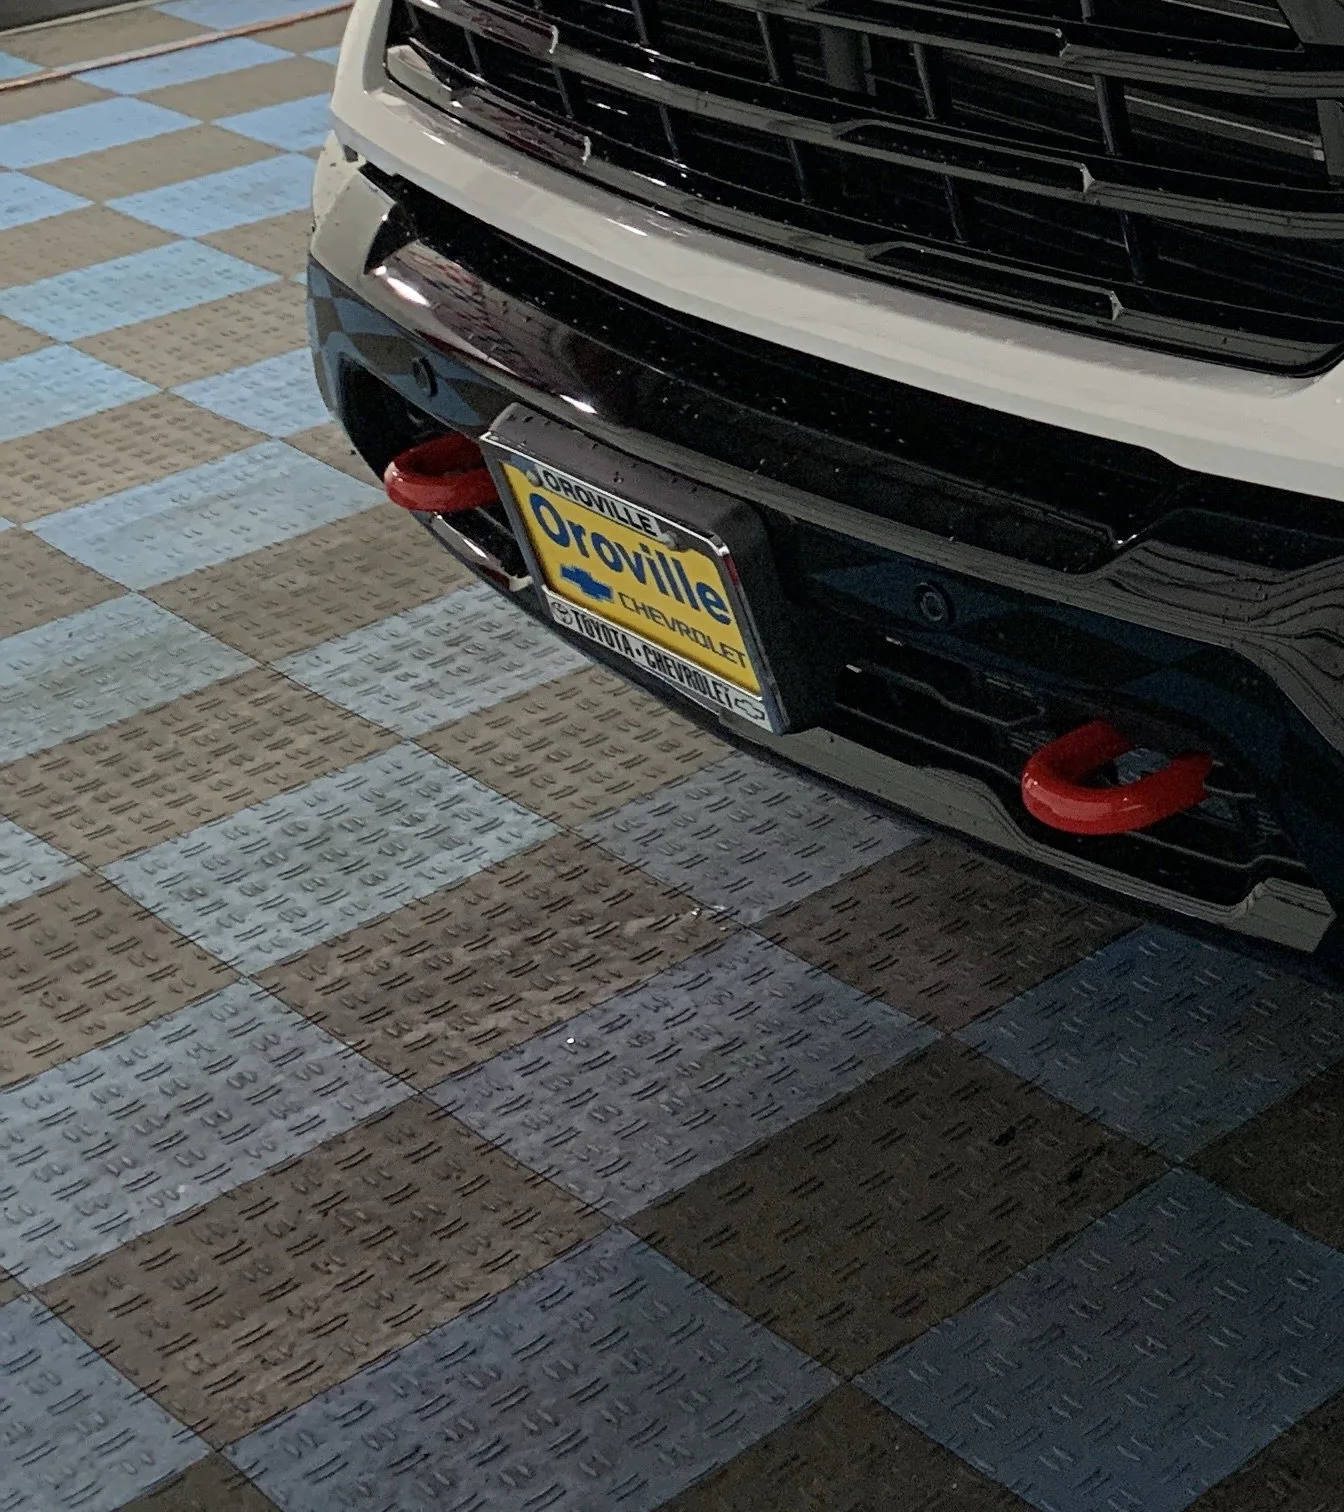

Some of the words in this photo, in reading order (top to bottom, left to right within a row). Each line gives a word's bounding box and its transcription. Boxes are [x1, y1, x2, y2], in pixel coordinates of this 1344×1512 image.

[542, 470, 658, 537] OROVILLE
[529, 492, 731, 625] Oroville
[571, 609, 635, 658] TOYOTA
[642, 643, 734, 709] CHEVROLET
[617, 591, 747, 669] CHEVROLET
